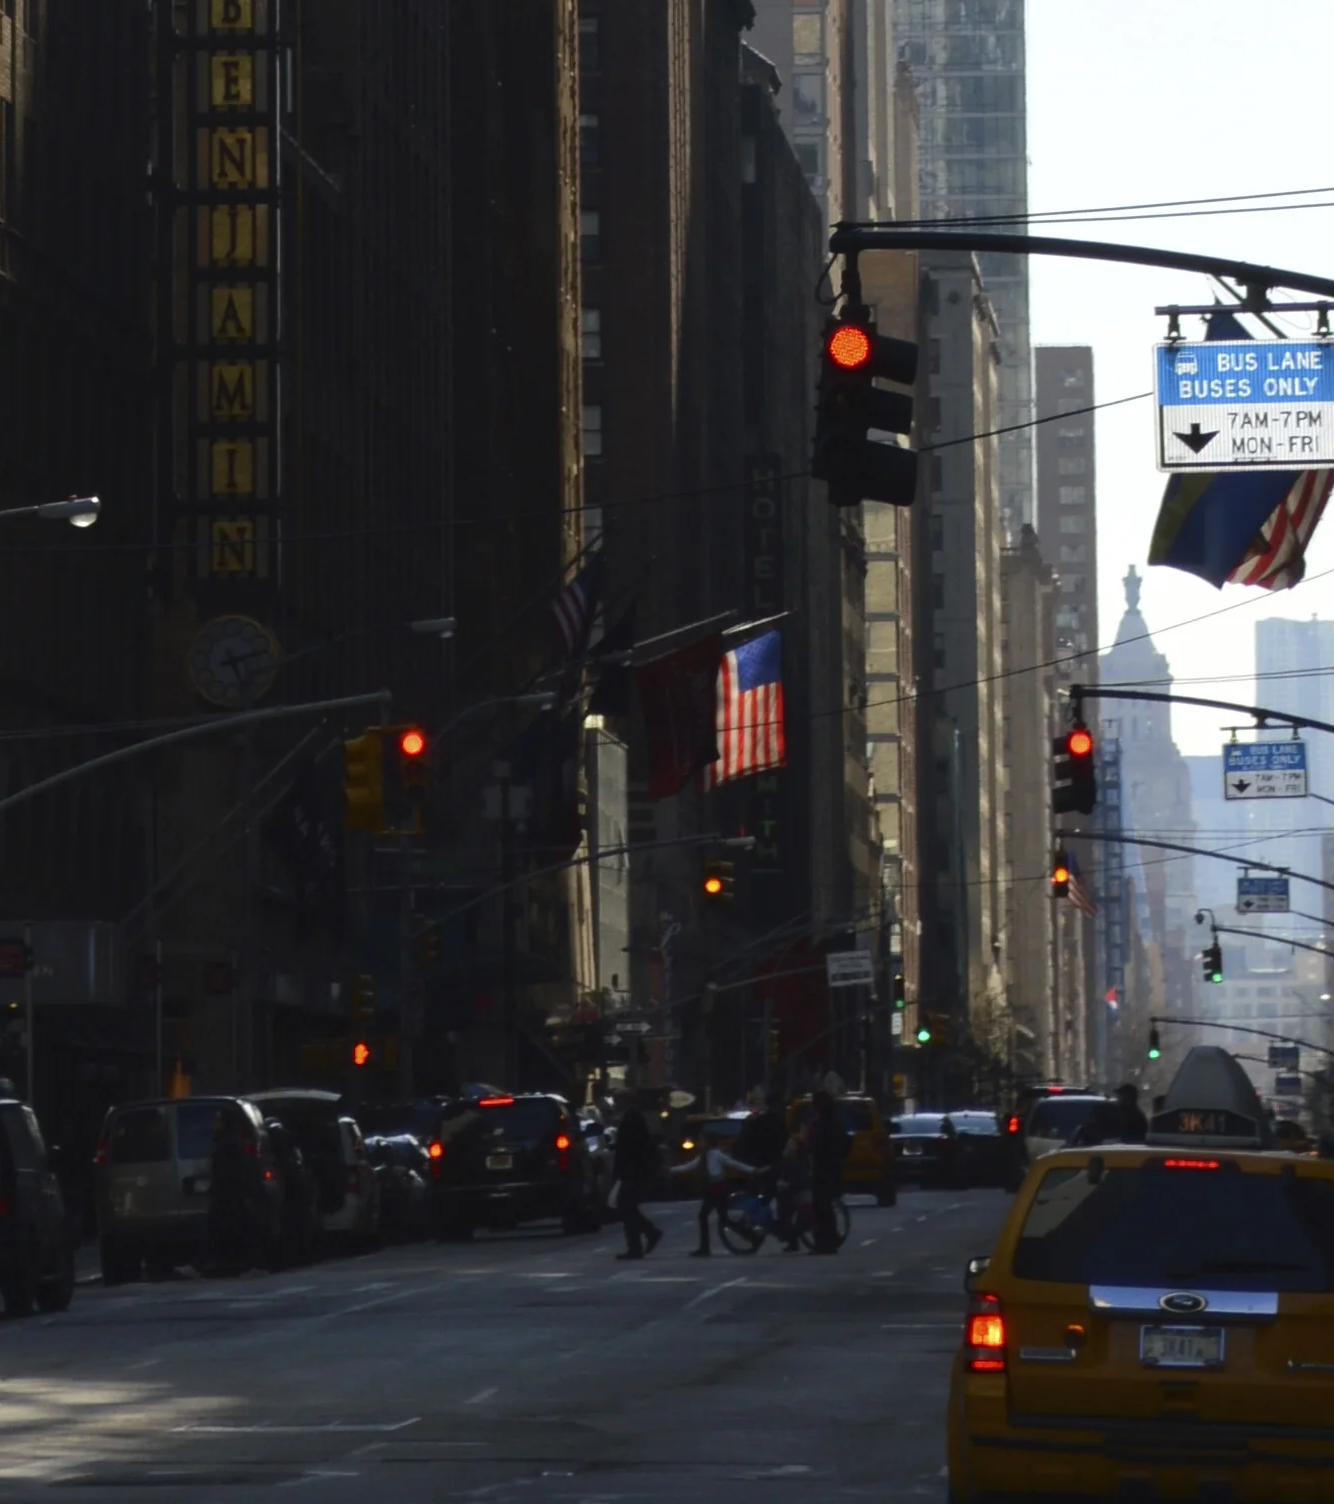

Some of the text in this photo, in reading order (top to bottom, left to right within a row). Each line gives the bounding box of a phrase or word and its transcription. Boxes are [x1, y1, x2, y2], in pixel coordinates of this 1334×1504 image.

[1218, 351, 1323, 372] BUS LANE
[1179, 377, 1318, 398] BUSES ONLY
[753, 468, 775, 609] HOTEL
[1228, 755, 1301, 766] BUSES ONLY
